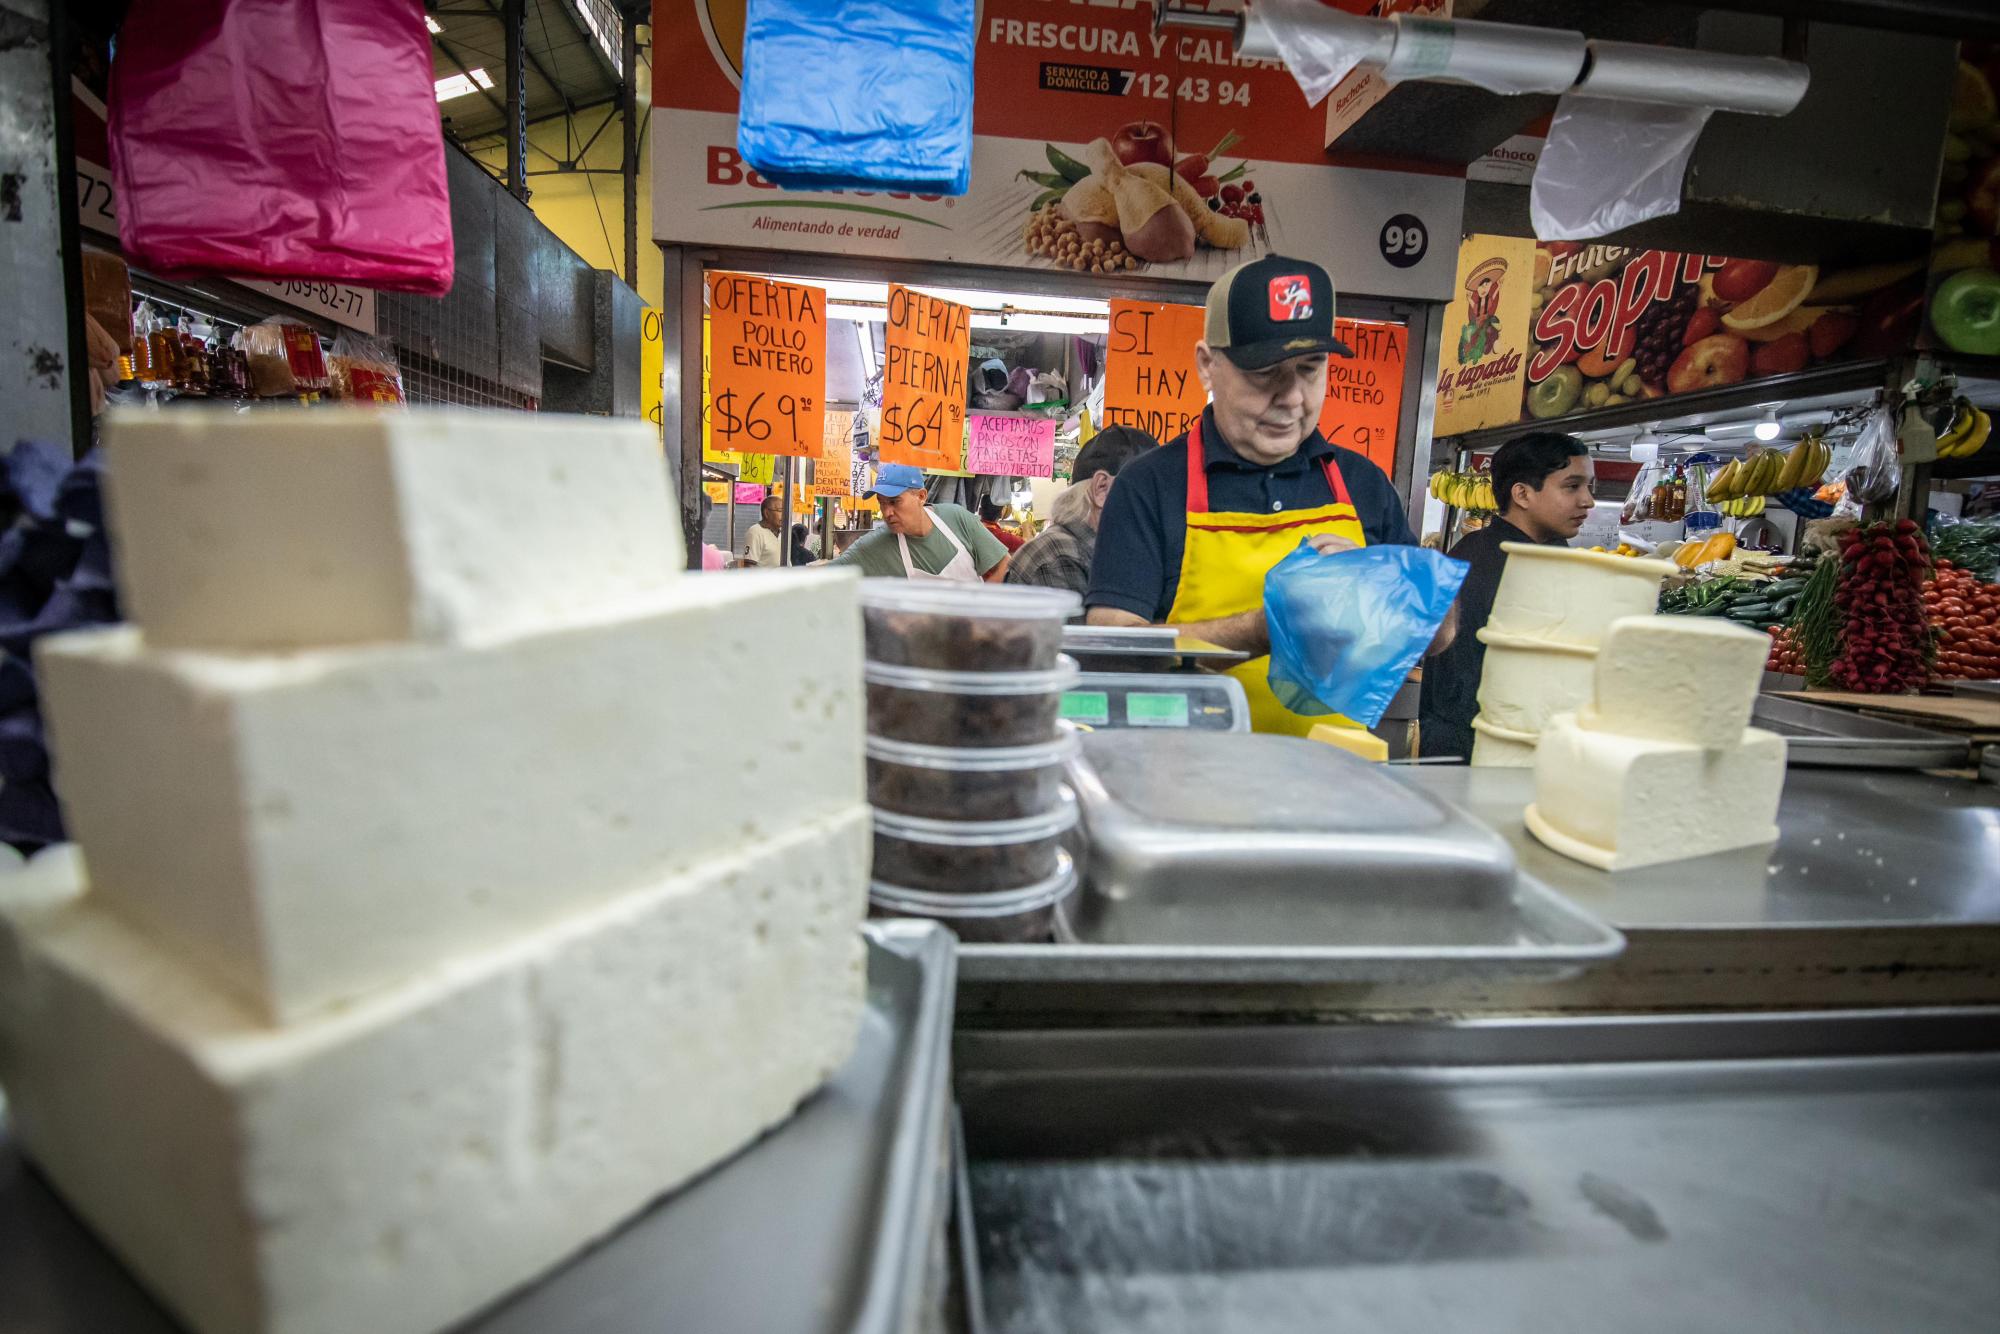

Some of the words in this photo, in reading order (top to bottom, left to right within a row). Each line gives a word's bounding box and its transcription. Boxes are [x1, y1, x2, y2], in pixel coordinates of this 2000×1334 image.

[990, 18, 1140, 57] FRESCURA
[1151, 34, 1168, 59] Y
[1176, 36, 1290, 72] CALI
[1045, 65, 1098, 80] SERVICIO
[1100, 72, 1109, 82] A
[1047, 76, 1110, 92] DOMICILIO
[1120, 70, 1170, 99] 712
[1177, 77, 1210, 103] 43
[1217, 81, 1250, 107] 94
[1486, 147, 1536, 163] achoco
[752, 215, 834, 236] Alimentando
[837, 218, 854, 237] de
[857, 225, 901, 240] verdad
[1385, 225, 1423, 256] 99
[714, 276, 817, 324] OFERTA
[889, 288, 969, 347] OFERTA
[1111, 310, 1155, 355] SI
[743, 320, 806, 351] POLLO
[1335, 325, 1401, 363] ERTA
[732, 346, 813, 375] ENTERO
[888, 345, 964, 400] PIERNA
[1329, 364, 1376, 387] POLLO
[1136, 366, 1188, 400] HAY
[716, 387, 797, 442] $69
[883, 397, 943, 449] $64
[981, 416, 1045, 436] ACEPTAMOS
[977, 432, 1014, 448] PAGOS
